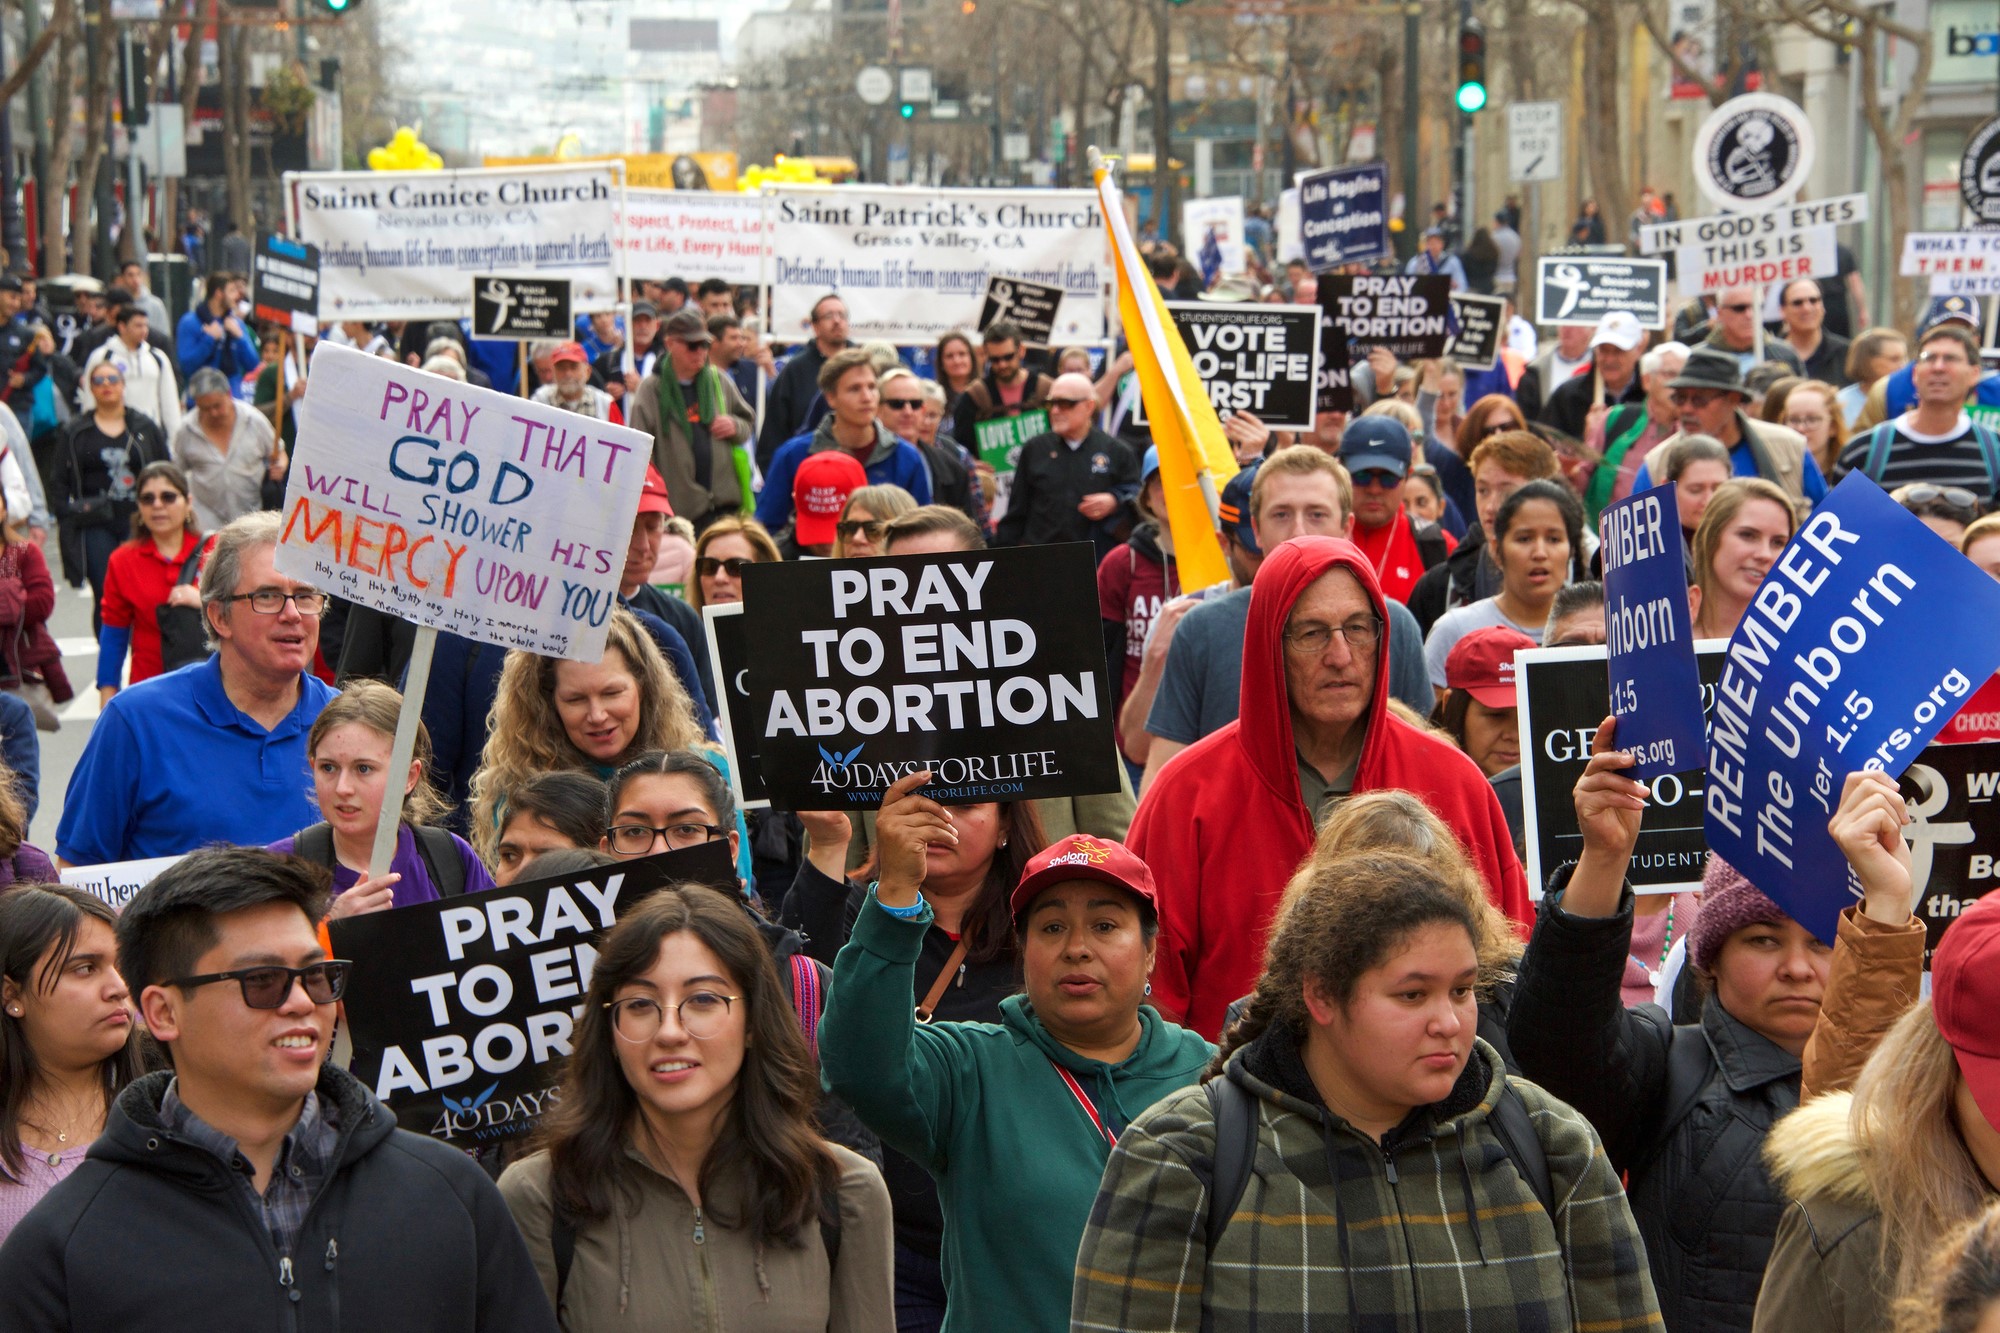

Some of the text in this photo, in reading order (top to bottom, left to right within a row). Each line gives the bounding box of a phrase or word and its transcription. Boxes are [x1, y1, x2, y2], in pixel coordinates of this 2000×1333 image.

[305, 184, 379, 210] Saint
[389, 182, 489, 209] Canice
[498, 177, 608, 206] Church
[1328, 174, 1380, 199] Begins
[376, 213, 448, 229] Nevada
[505, 207, 538, 224] CA
[780, 199, 852, 224] Saint
[863, 202, 988, 226] Patrick's
[997, 204, 1101, 228] Church
[1304, 211, 1381, 237] Conception
[1654, 200, 1854, 248] IN GOD'S EYES
[319, 238, 366, 276] efending
[366, 239, 404, 267] human
[405, 236, 425, 265] life
[425, 235, 456, 265] from
[457, 235, 519, 272] conception
[520, 238, 533, 263] to
[535, 232, 576, 262] natural
[853, 231, 913, 247] Grass
[995, 234, 1025, 248] CA
[1705, 234, 1803, 266] THIS IS
[1912, 238, 1967, 251] WHAT
[776, 255, 837, 290] Defending
[839, 260, 881, 287] human
[884, 259, 903, 287] life
[905, 260, 935, 288] from
[1352, 276, 1418, 297] PRAY
[1703, 256, 1812, 289] MURDER
[1179, 312, 1283, 325] STUDENTSFORLIFE.ORG
[1337, 296, 1429, 317] TO END
[1191, 324, 1287, 352] VOTE
[1192, 350, 1309, 381] O-LIFE
[1203, 380, 1271, 410] RST
[380, 381, 632, 484] PRAY THAT
[978, 421, 1015, 451] LOVE
[389, 435, 534, 505] GOD
[304, 465, 614, 574] WILL SHOWER HIS
[1601, 495, 1665, 575] EMBER
[280, 496, 612, 628] MERCY UPON YOU
[315, 561, 333, 580] Holy
[339, 570, 358, 588] God,
[368, 580, 387, 594] Holy
[453, 608, 480, 626] Holy
[830, 560, 994, 619] PRAY
[342, 585, 365, 603] Have
[424, 617, 434, 626] us
[444, 623, 459, 632] and
[488, 631, 504, 642] the
[508, 635, 535, 649] whole
[541, 642, 567, 657] world.
[801, 619, 1037, 678] TO END
[1707, 511, 1861, 838] REMEMBER
[764, 671, 1099, 738] ABORTION
[1614, 679, 1638, 715] 1:5
[1757, 563, 1917, 870] The Unborn
[1955, 712, 2000, 732] CHOOS
[1809, 689, 1874, 814] Jer 1:5
[851, 760, 918, 789] DAYS
[923, 756, 994, 785] FOR
[1047, 851, 1089, 868] Shalom
[439, 873, 626, 961] PRAY
[410, 942, 601, 1027] TO EN
[375, 1005, 587, 1100] ABOR
[483, 1085, 562, 1127] DAYS
